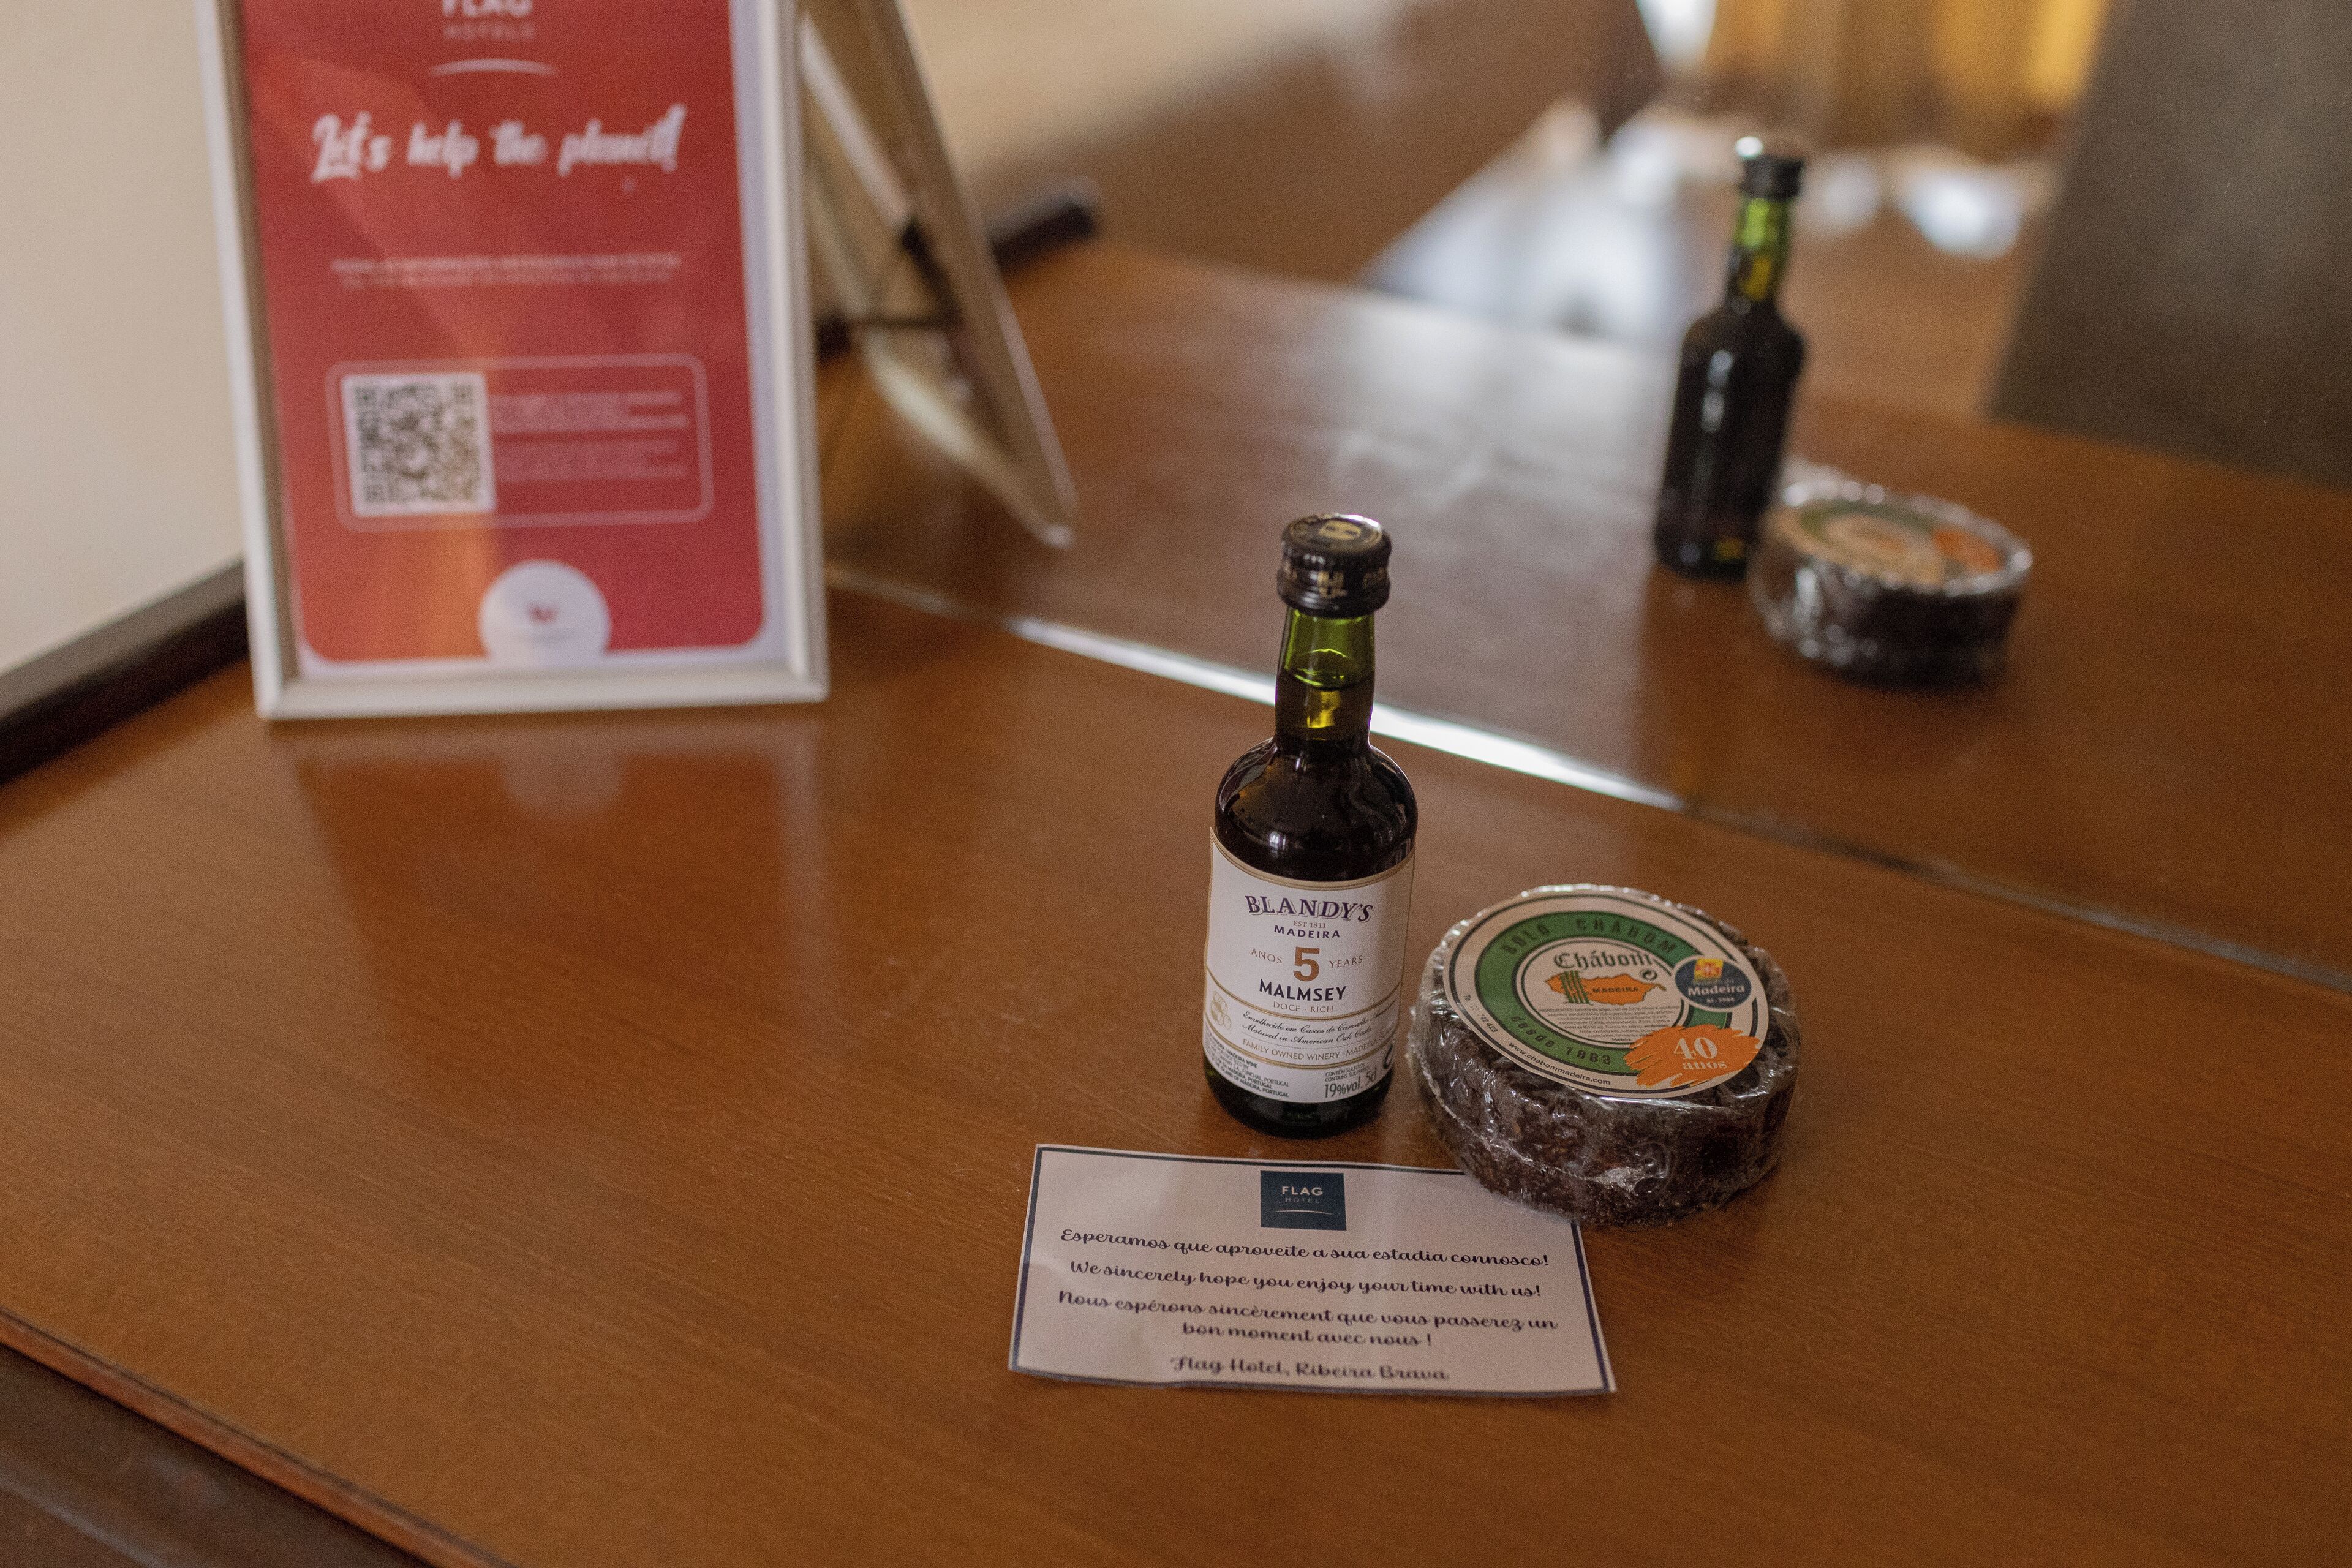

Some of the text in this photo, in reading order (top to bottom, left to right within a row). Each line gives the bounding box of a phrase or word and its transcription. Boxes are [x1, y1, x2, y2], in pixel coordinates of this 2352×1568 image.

[309, 112, 392, 183] Let's
[406, 119, 480, 179] help
[489, 119, 548, 165] the
[1245, 895, 1374, 923] BLANDY'S
[1274, 925, 1340, 938] MADEIRA
[1251, 946, 1363, 982] ANOS 5 YEARS
[1259, 979, 1347, 1001] MALMSEY
[1687, 984, 1745, 997] Madeira
[1273, 1001, 1300, 1012] DOCE
[1242, 1023, 1277, 1039] Matured
[1279, 1033, 1287, 1042] in
[1291, 1035, 1334, 1044] American
[1336, 1032, 1352, 1042] Oak
[1243, 1011, 1284, 1030] Envelhecido
[1300, 1024, 1324, 1033] Cascos
[1337, 1017, 1368, 1031] Carvalho
[1242, 1038, 1270, 1054] FAMILY
[1272, 1049, 1305, 1060] OWNED
[1306, 1051, 1340, 1061] WINERY
[1566, 1046, 1611, 1065] 1983
[1674, 1037, 1718, 1060] 40
[1508, 1042, 1611, 1086] www.chabommadeira.com
[1683, 1060, 1727, 1070] anos
[1281, 1186, 1323, 1196] FLAG
[1060, 1228, 1550, 1267] Esperamos que aproveite a sua estadia connosco!
[1070, 1261, 1542, 1297] We sincerely hope you enjoy your time with us!
[1058, 1290, 1558, 1332] Nous espérons sincèrement que vous passerez un
[1182, 1322, 1224, 1336] bon
[1227, 1325, 1314, 1343] moment
[1317, 1332, 1365, 1345] avec
[1368, 1333, 1423, 1347] nous
[1170, 1355, 1450, 1381] Flag Hotel, Ribeira Brava
